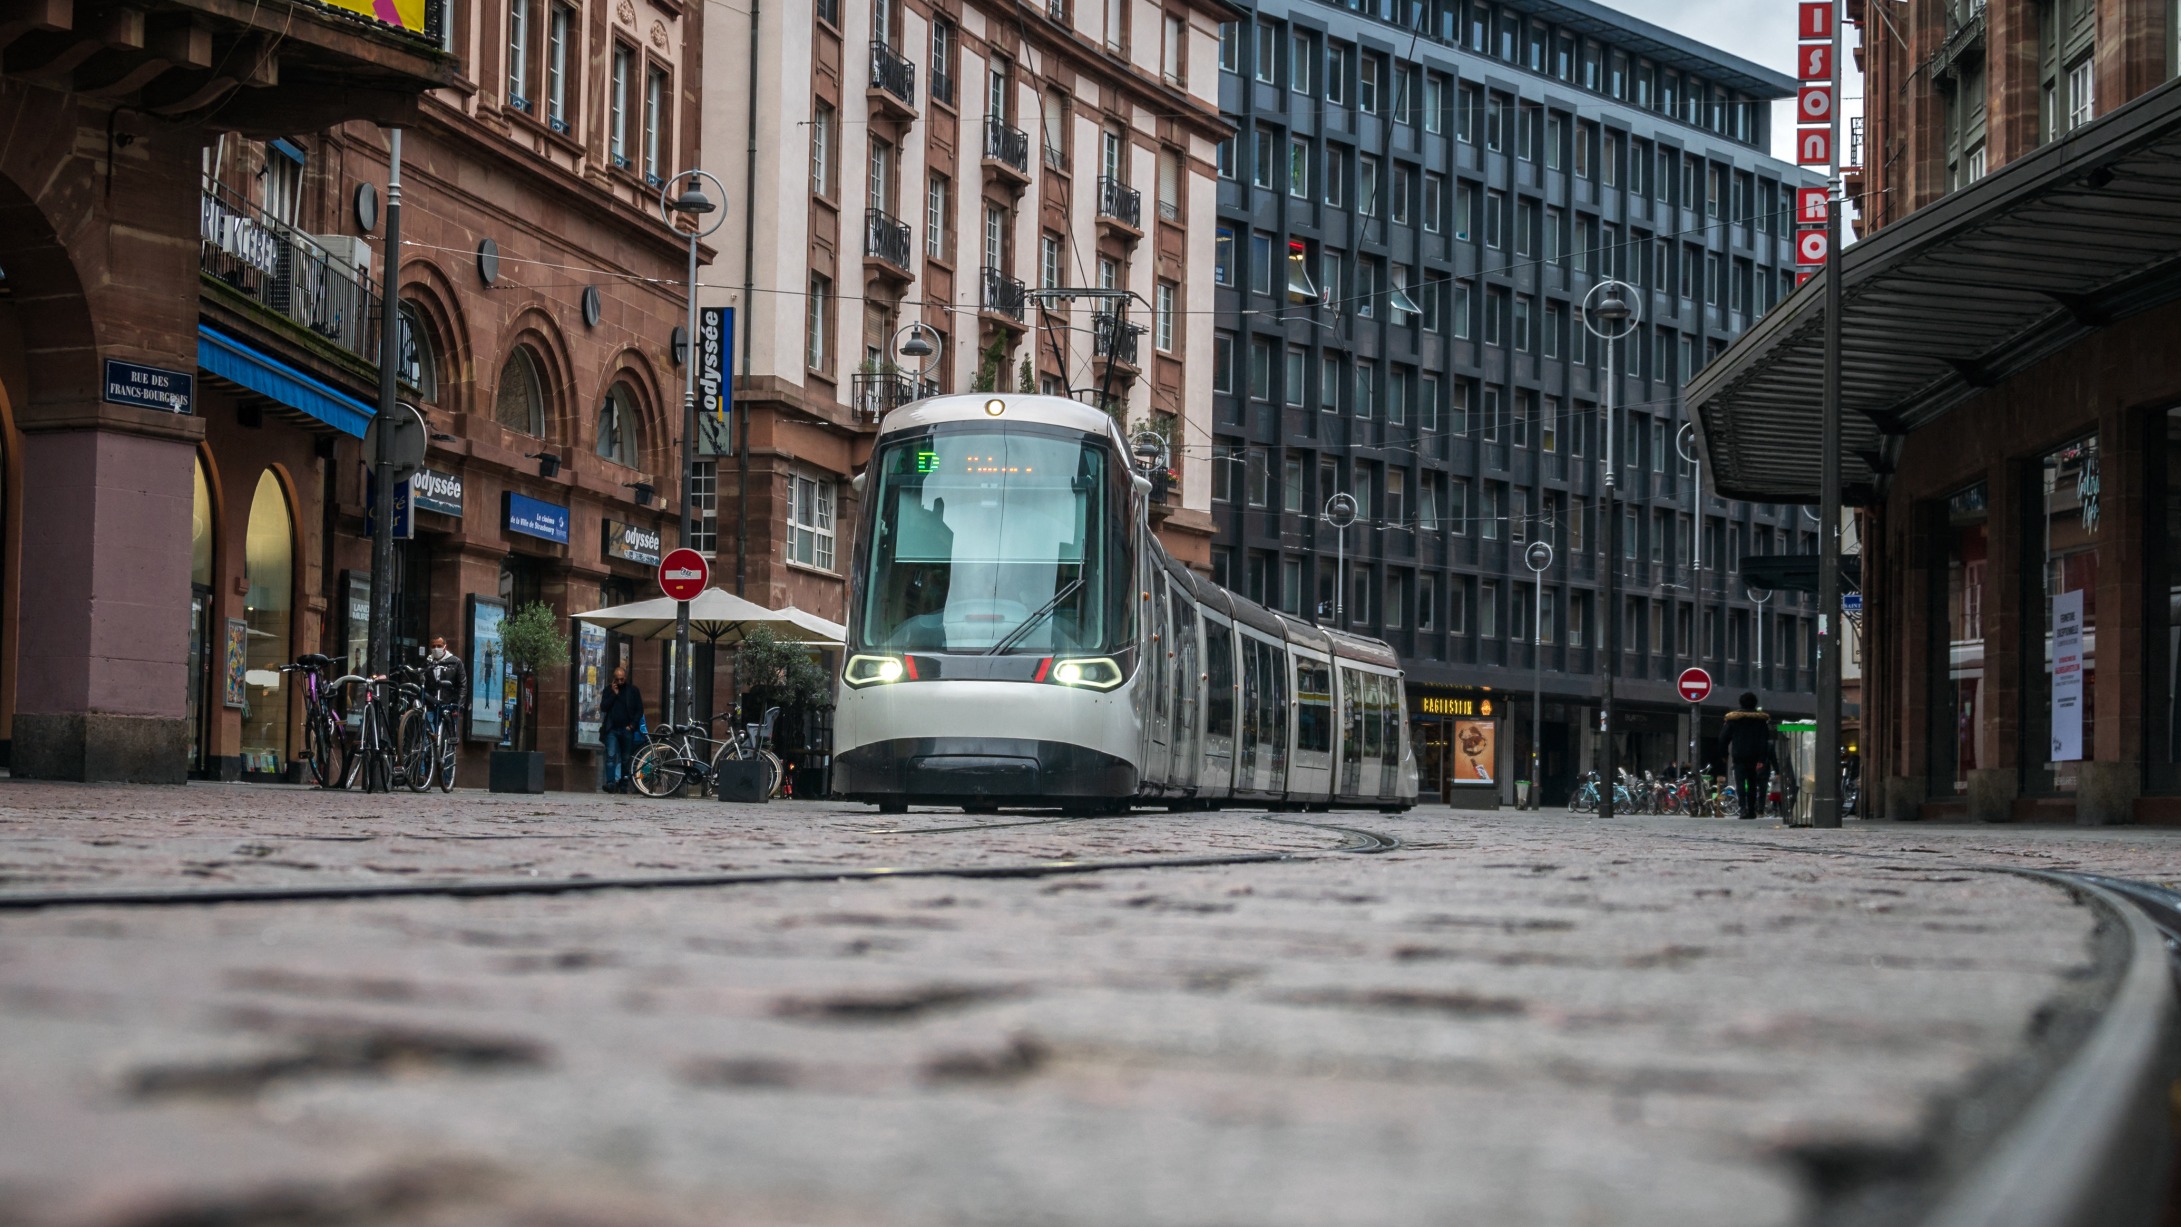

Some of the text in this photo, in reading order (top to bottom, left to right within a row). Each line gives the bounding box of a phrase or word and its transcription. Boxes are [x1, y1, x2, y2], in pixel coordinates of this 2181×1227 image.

[700, 311, 722, 411] odyssée
[131, 371, 169, 388] RUE DES
[414, 469, 461, 498] odyssée
[625, 527, 660, 551] odyssée
